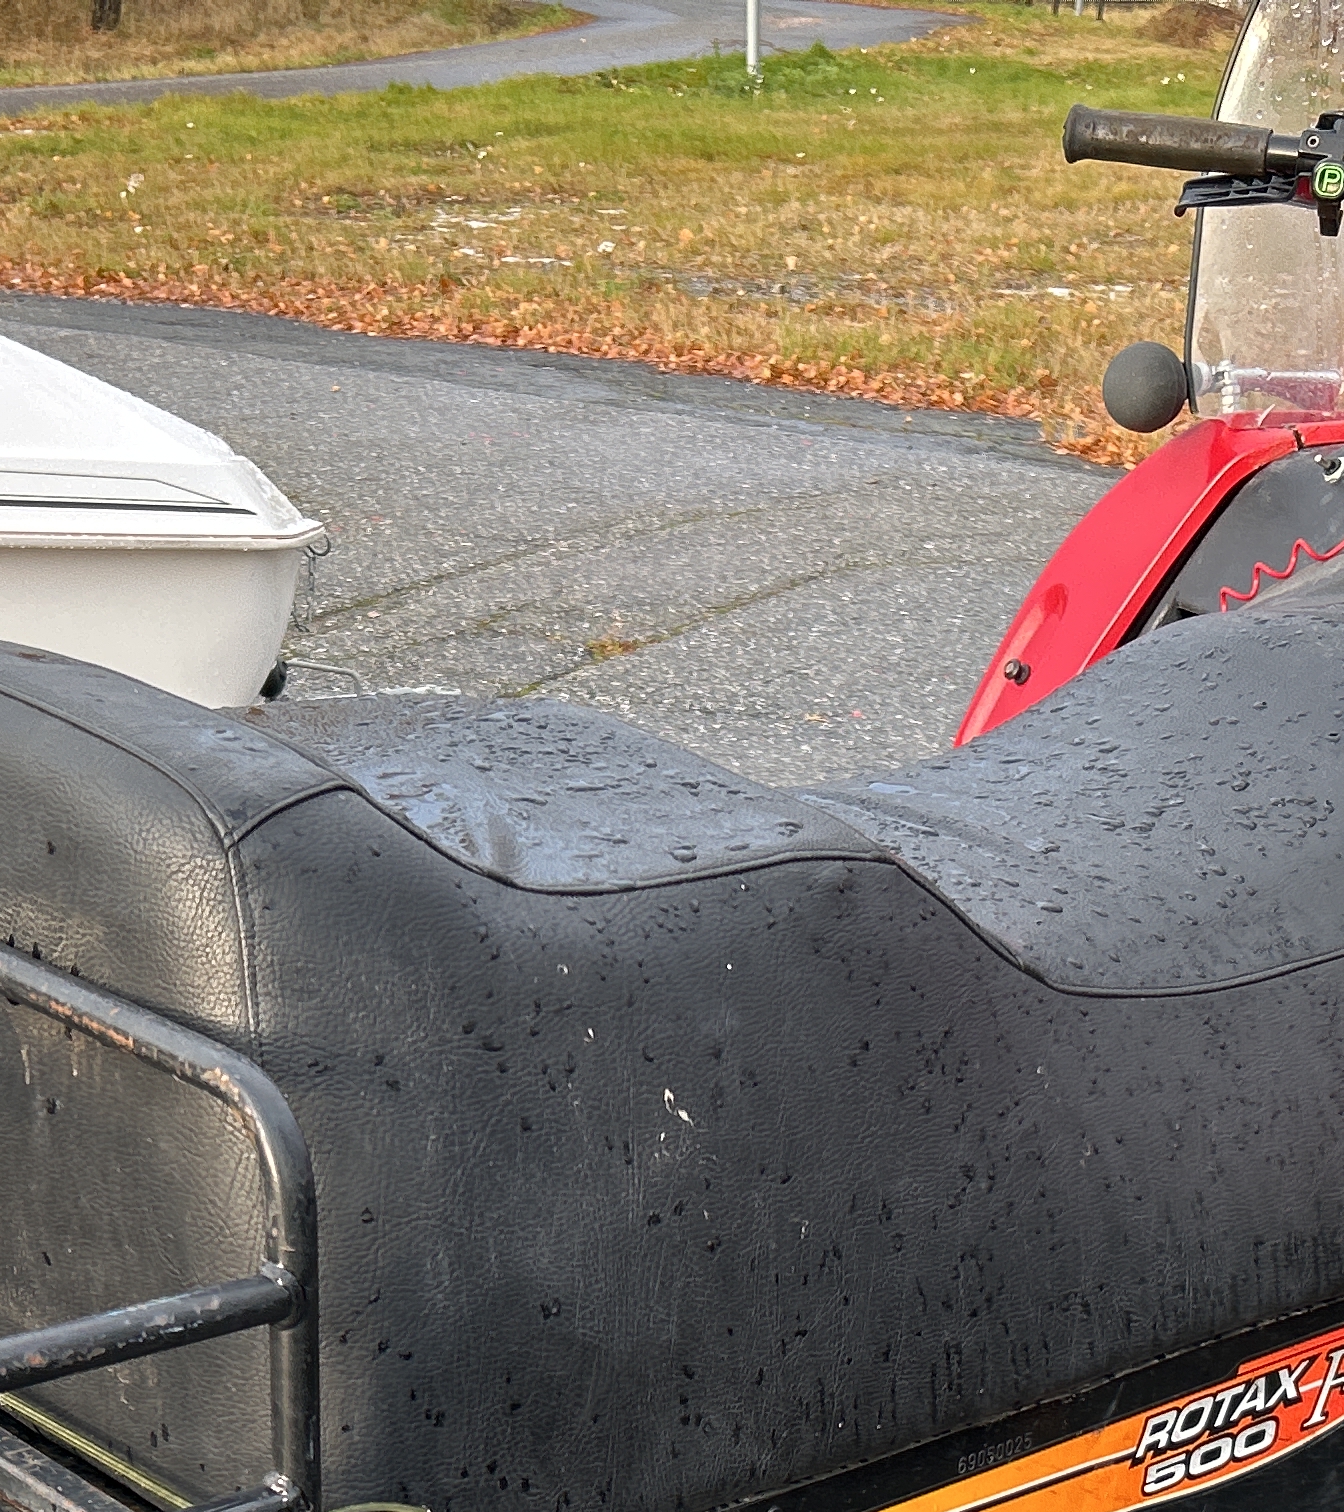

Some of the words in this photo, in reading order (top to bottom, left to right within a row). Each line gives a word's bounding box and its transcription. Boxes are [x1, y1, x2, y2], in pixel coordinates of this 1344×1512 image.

[1134, 1358, 1313, 1460] ROTAX
[957, 1431, 1033, 1474] 69050025
[1142, 1418, 1278, 1495] 500
